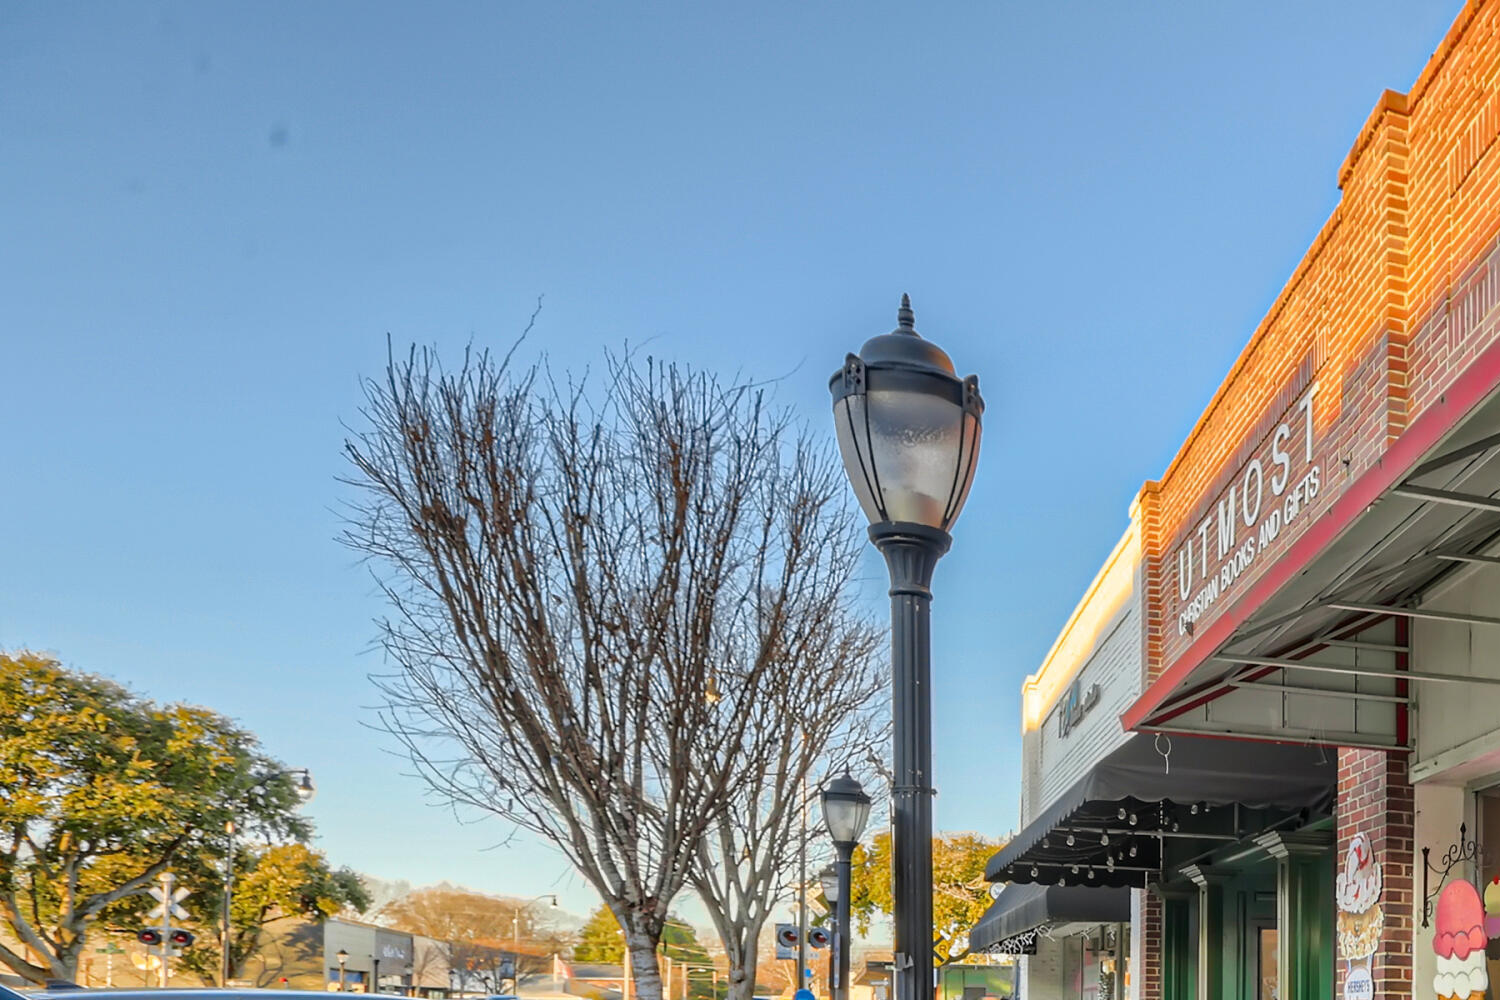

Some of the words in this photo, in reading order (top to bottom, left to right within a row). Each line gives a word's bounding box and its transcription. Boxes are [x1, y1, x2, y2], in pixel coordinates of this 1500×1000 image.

[1178, 380, 1320, 601] UTMOST
[1178, 574, 1220, 637] CHRISTIAN
[1220, 536, 1256, 594] BOOKS
[1257, 508, 1281, 554] AND
[1283, 465, 1321, 526] GIFTS
